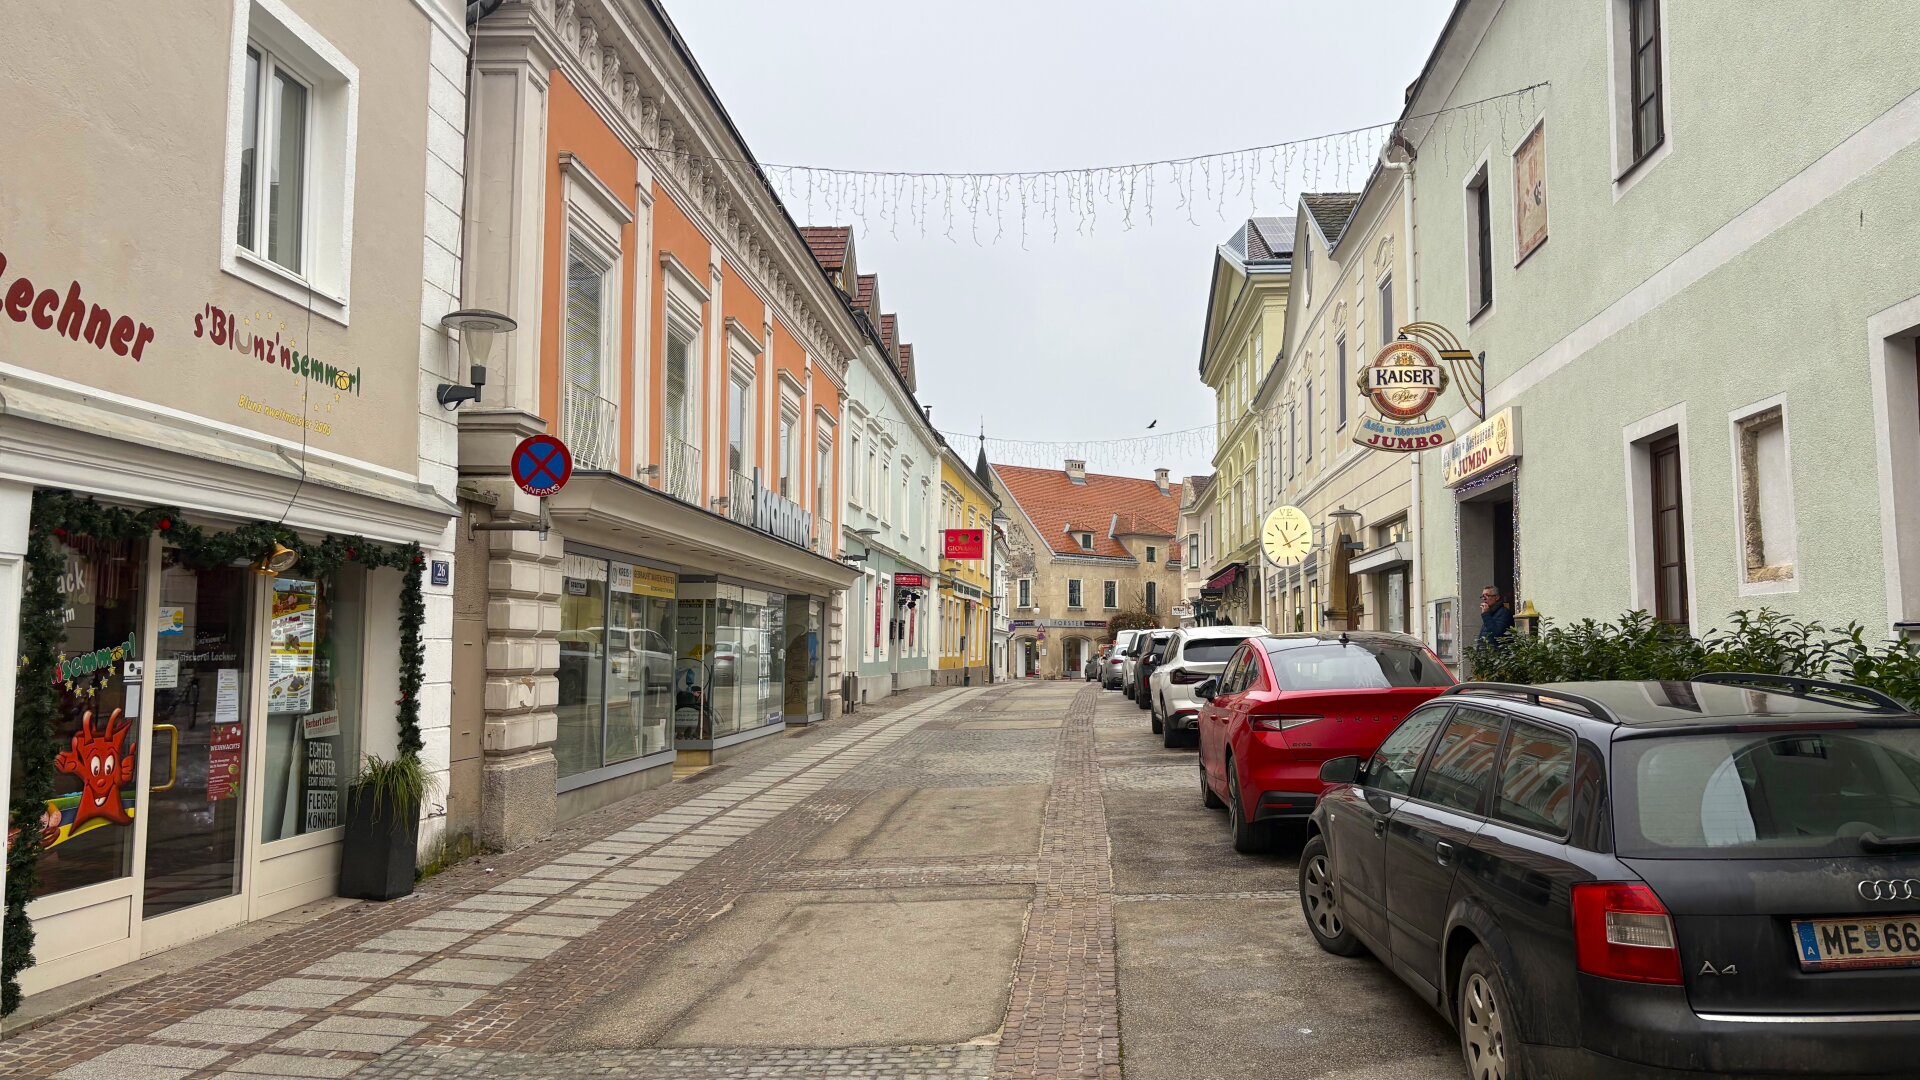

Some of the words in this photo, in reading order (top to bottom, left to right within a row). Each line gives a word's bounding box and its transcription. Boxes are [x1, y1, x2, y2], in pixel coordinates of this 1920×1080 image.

[0, 252, 155, 362] echner
[1376, 369, 1434, 385] KAISER
[1391, 390, 1418, 404] Bier
[1363, 420, 1385, 433] Asia
[1394, 420, 1447, 436] Restaurant
[1367, 433, 1443, 449] JUMBO
[1465, 421, 1494, 452] Restaurant
[1458, 447, 1487, 477] JUMBO
[522, 483, 560, 495] ANFANG
[1279, 508, 1293, 516] VE
[437, 563, 446, 577] 26
[306, 717, 321, 729] Herbert
[309, 741, 332, 759] ECHTER
[308, 792, 337, 810] FLEISCH
[1807, 946, 1816, 955] A
[1821, 925, 1863, 955] ME
[1883, 923, 1920, 953] 66
[1698, 960, 1738, 976] A4
